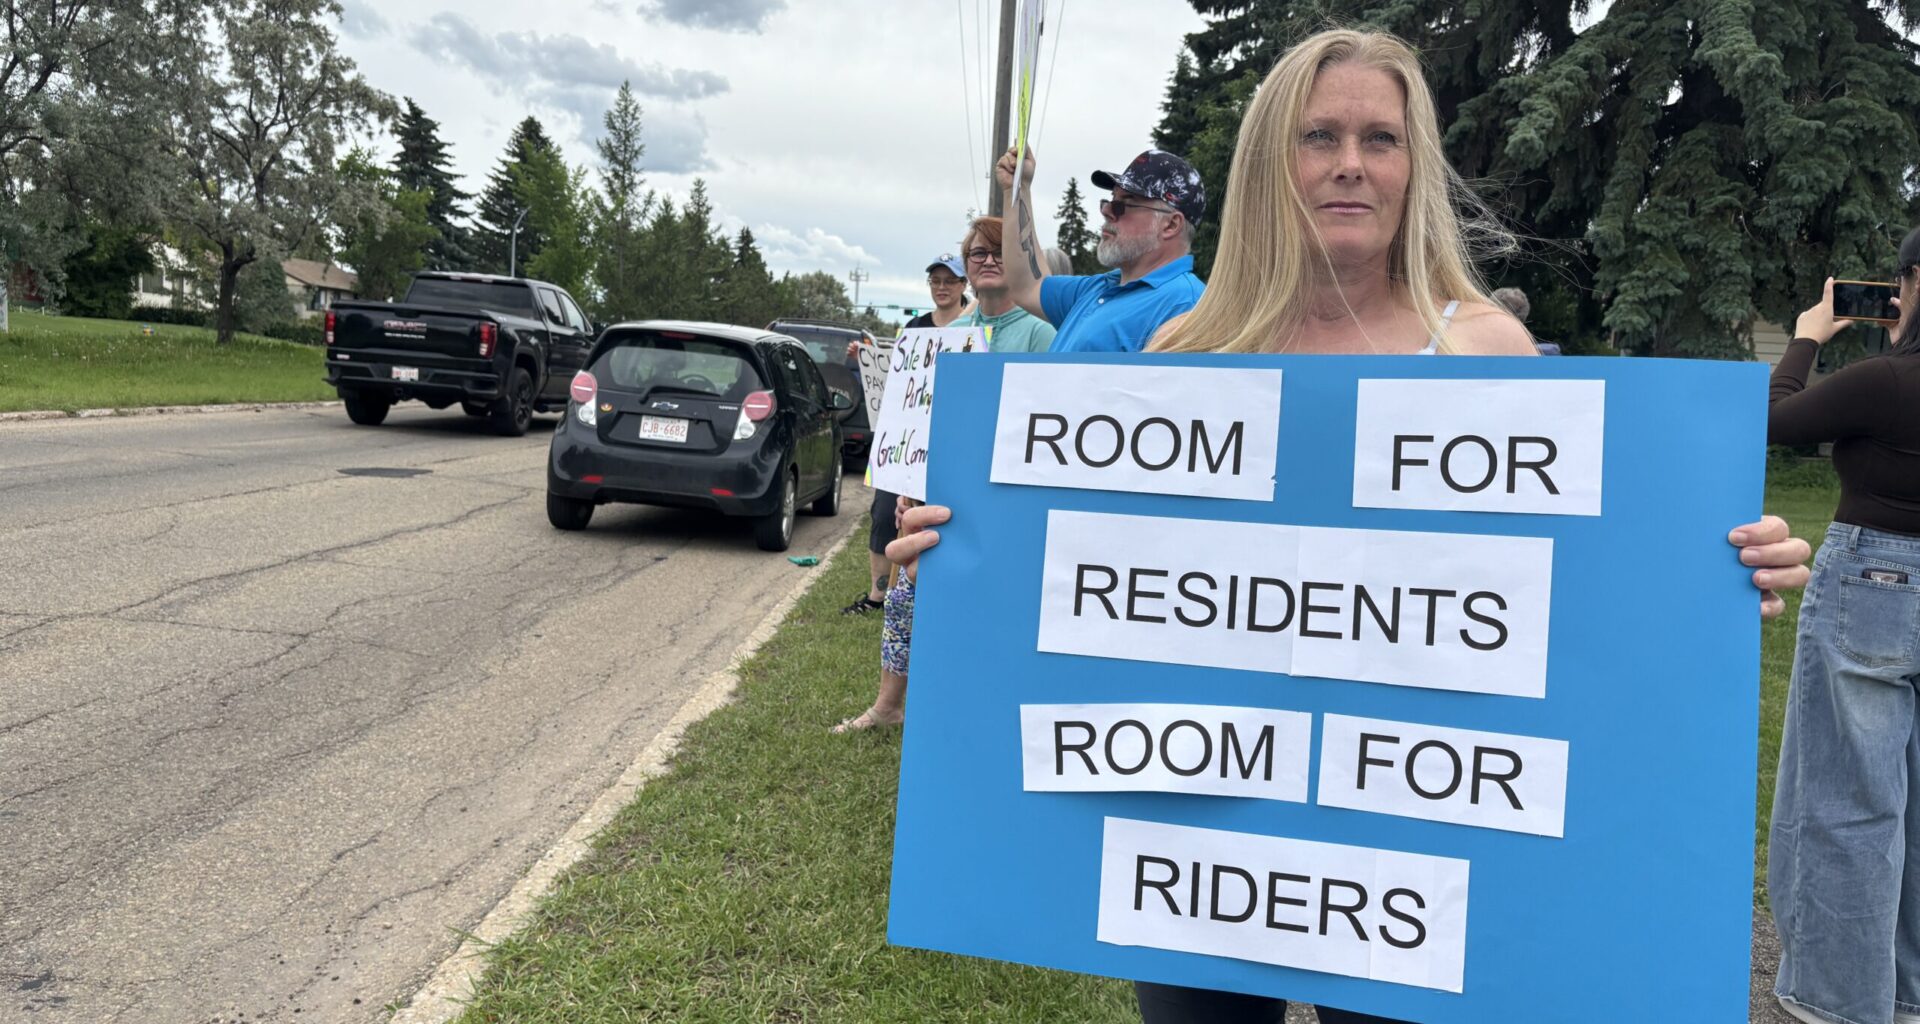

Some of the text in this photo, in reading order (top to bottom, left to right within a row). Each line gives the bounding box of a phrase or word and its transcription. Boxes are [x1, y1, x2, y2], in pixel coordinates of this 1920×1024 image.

[877, 428, 907, 468] Great
[1024, 413, 1561, 495] ROOM FOR
[1072, 563, 1508, 651] RESIDENTS
[1054, 719, 1525, 811] ROOM FOR
[1133, 854, 1427, 949] RIDERS
